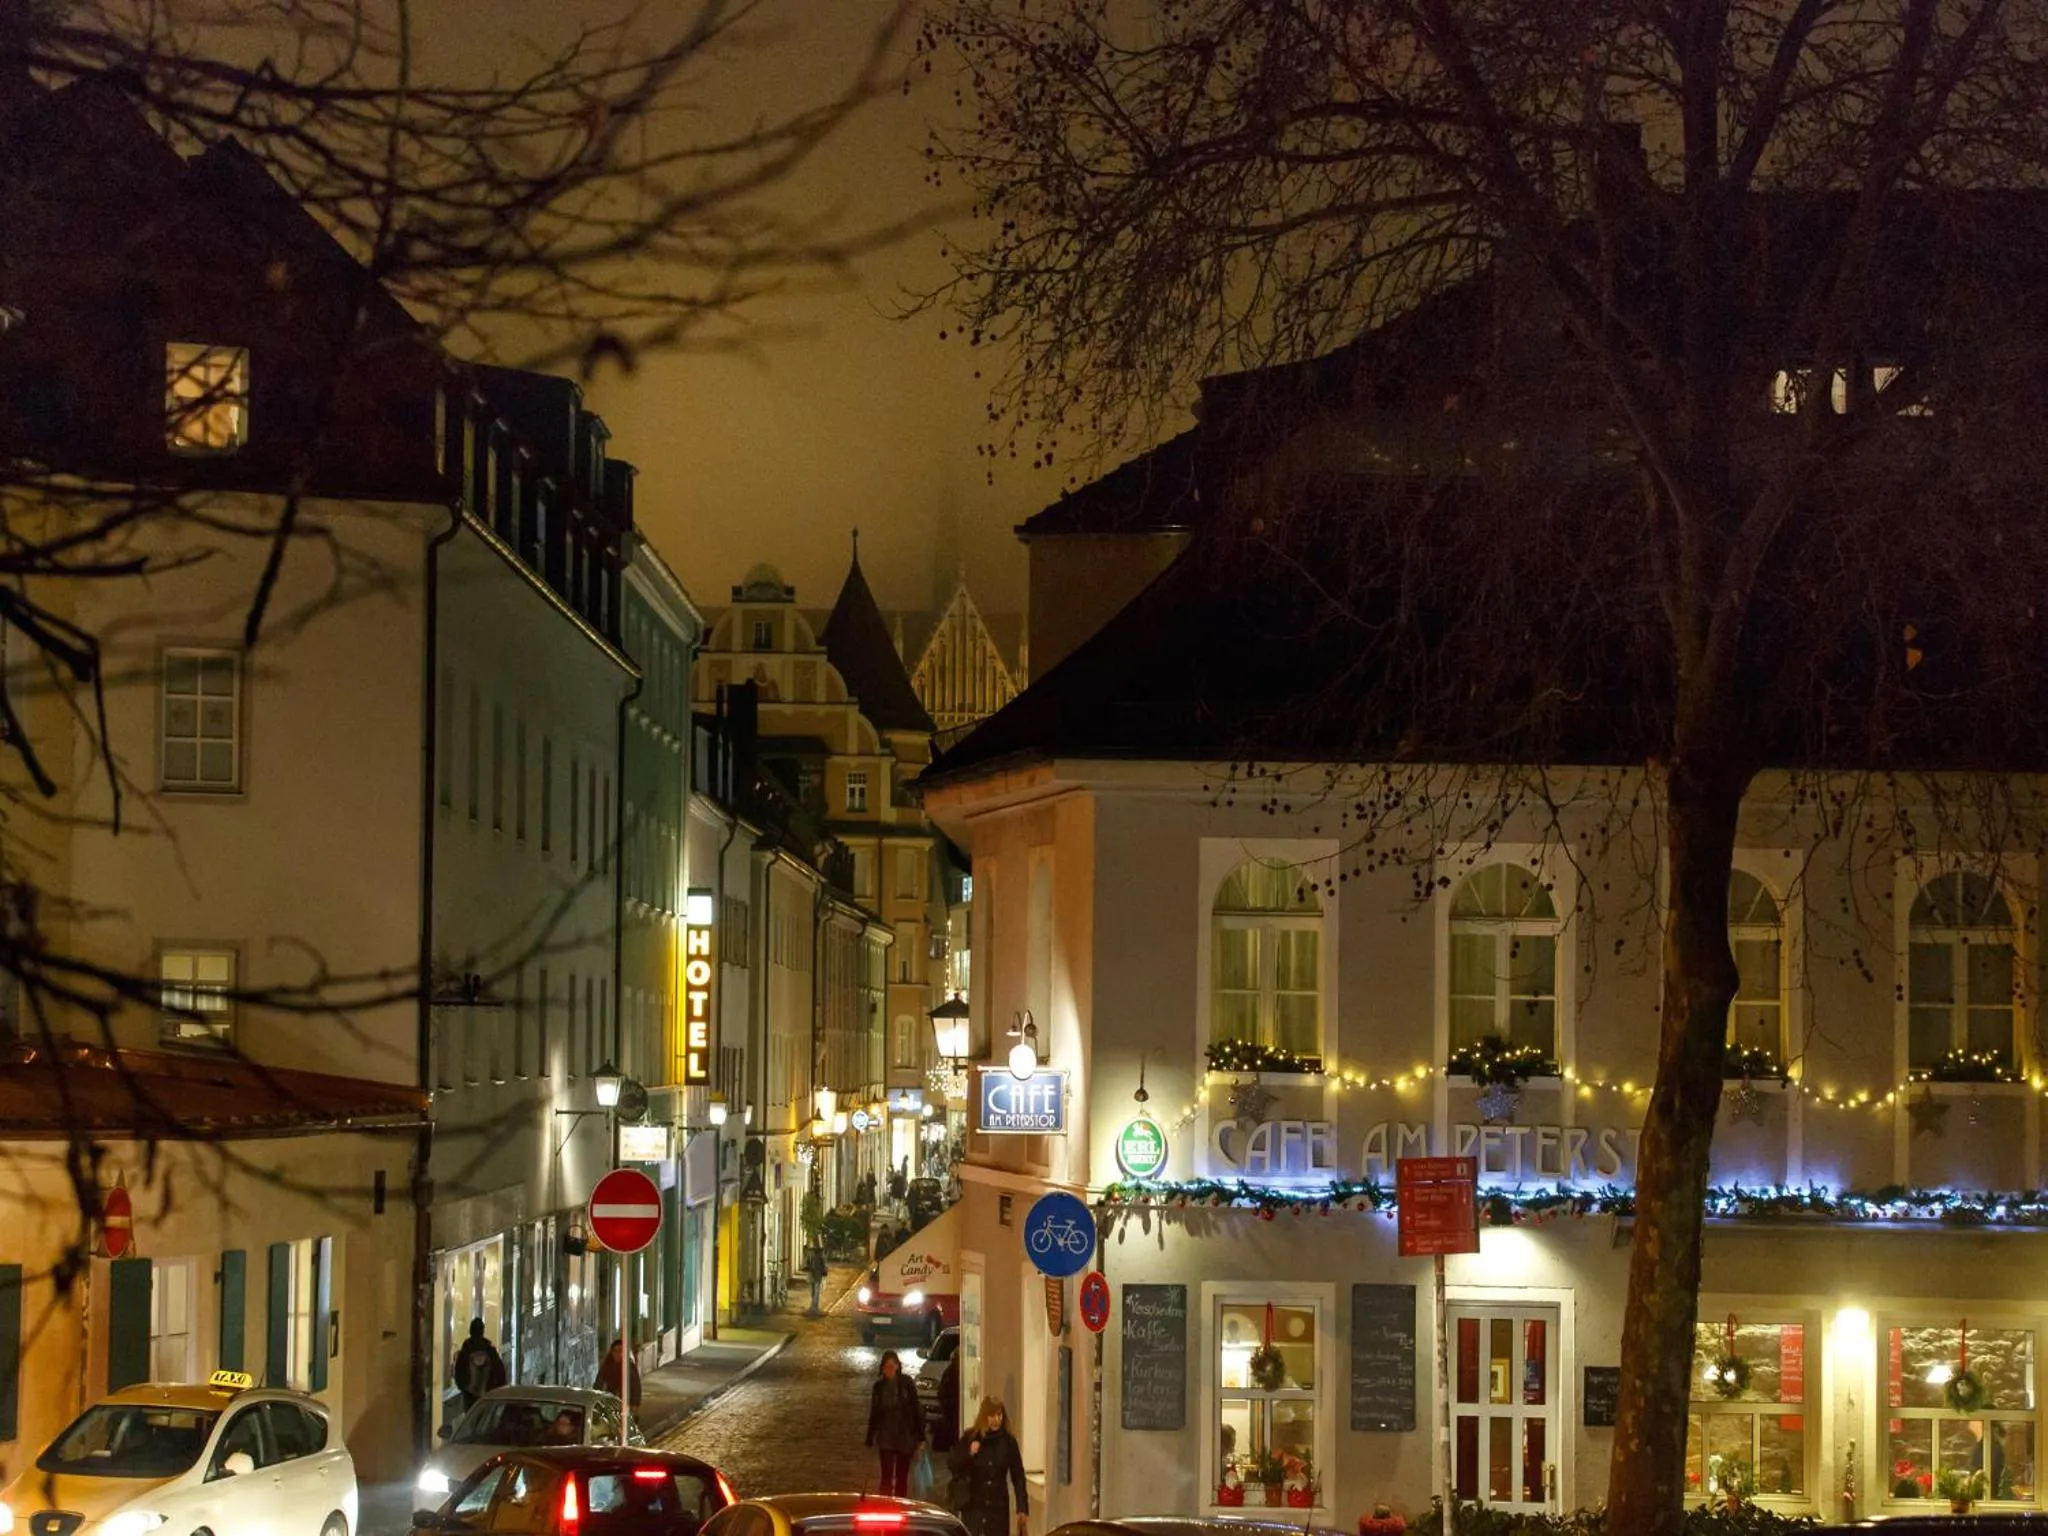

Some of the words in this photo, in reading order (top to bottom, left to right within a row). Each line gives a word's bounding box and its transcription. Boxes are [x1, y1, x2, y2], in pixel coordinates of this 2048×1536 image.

[686, 930, 710, 1078] HOTEL
[987, 1083, 1056, 1114] CAFE
[990, 1114, 1003, 1127] AM
[1005, 1114, 1056, 1128] PETERSTOR
[1213, 1119, 1335, 1175] CAFE
[1362, 1122, 1427, 1180] AM
[900, 1264, 933, 1277] Candy
[214, 1373, 246, 1384] TAXI
